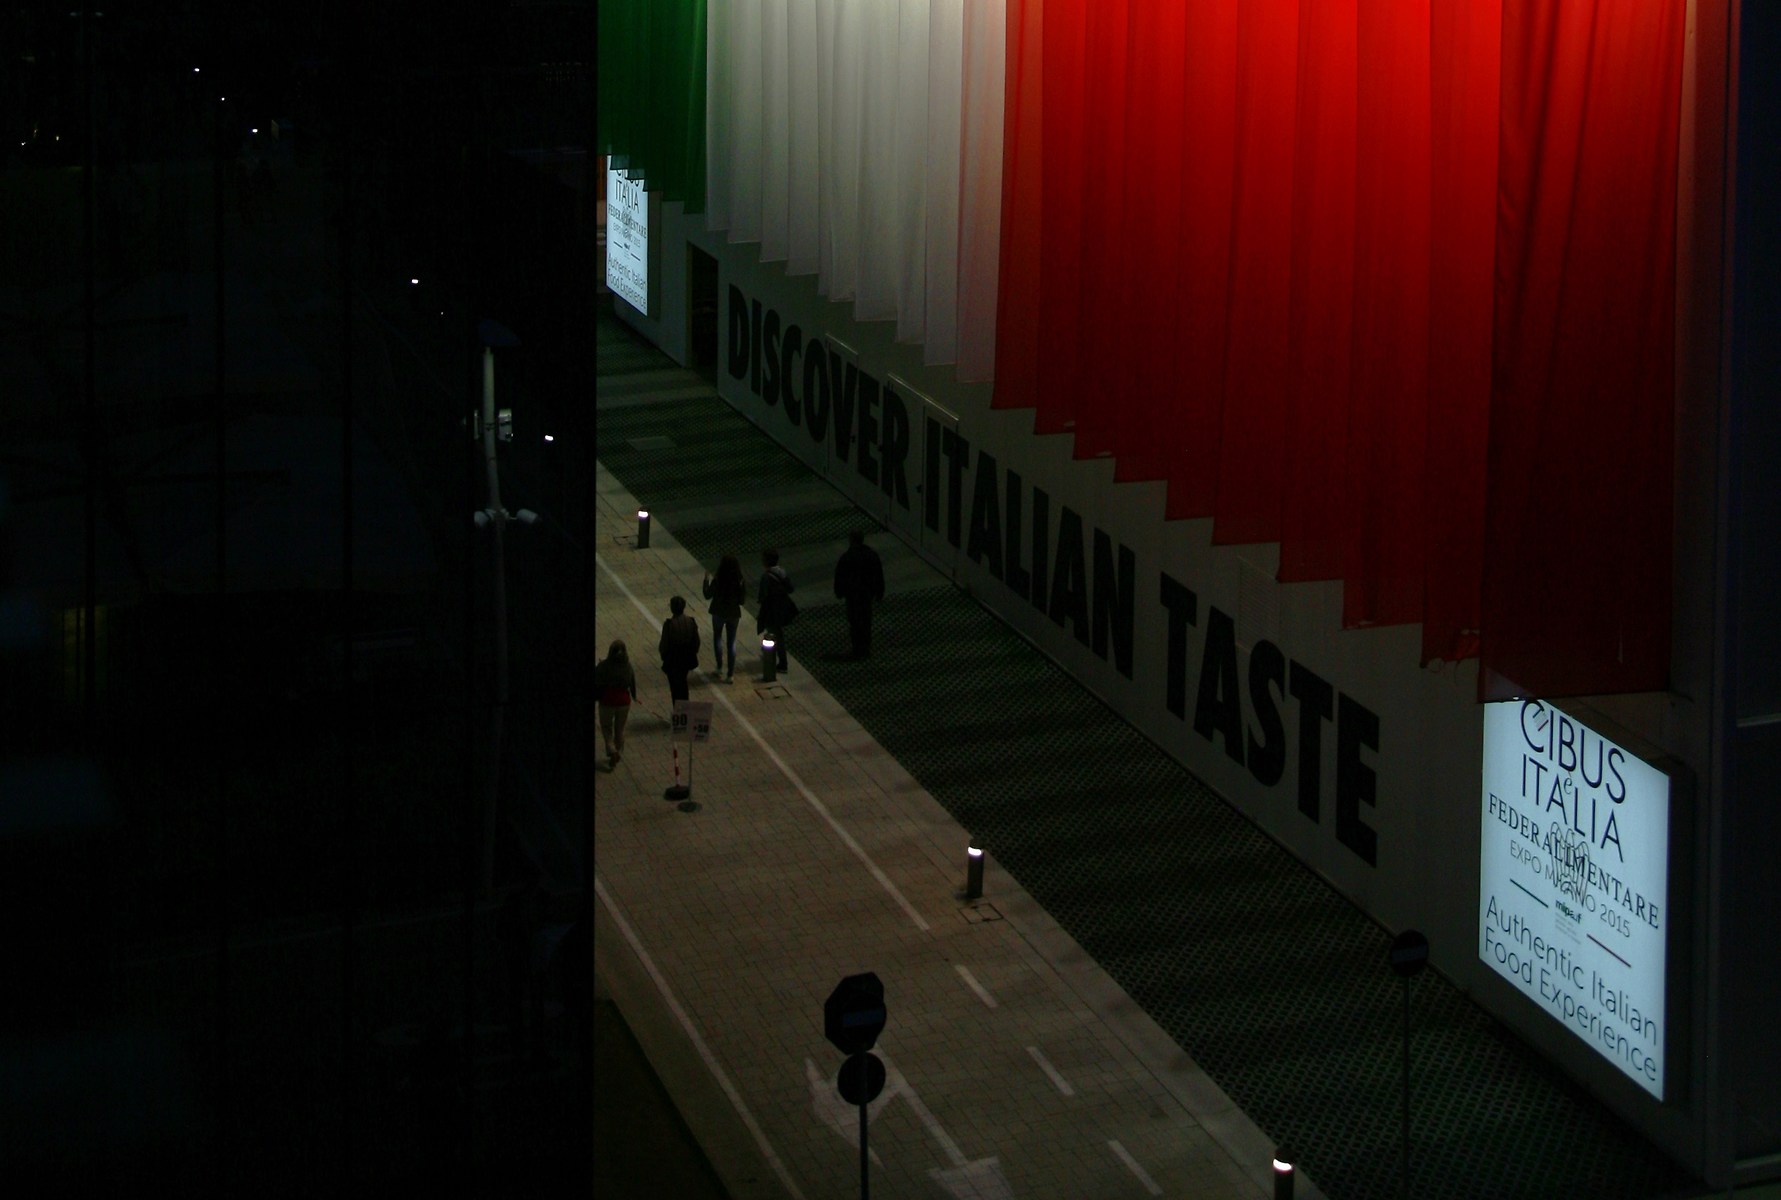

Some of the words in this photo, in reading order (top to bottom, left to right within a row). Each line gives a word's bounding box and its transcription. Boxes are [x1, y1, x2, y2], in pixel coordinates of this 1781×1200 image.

[729, 283, 910, 511] DISCOVER
[925, 416, 1135, 680] ITALIAN
[1160, 571, 1379, 868] TASTE
[1520, 700, 1625, 804] CIBUS
[1522, 753, 1624, 863] ITALIA
[1489, 793, 1659, 929] FEDERALIMENTARE
[1510, 840, 1541, 874] EXPO
[1600, 903, 1630, 938] 2015
[1485, 926, 1533, 986] Food
[1540, 968, 1657, 1082] Experience
[1486, 895, 1584, 990] Authentic
[1592, 970, 1657, 1046] Italian
